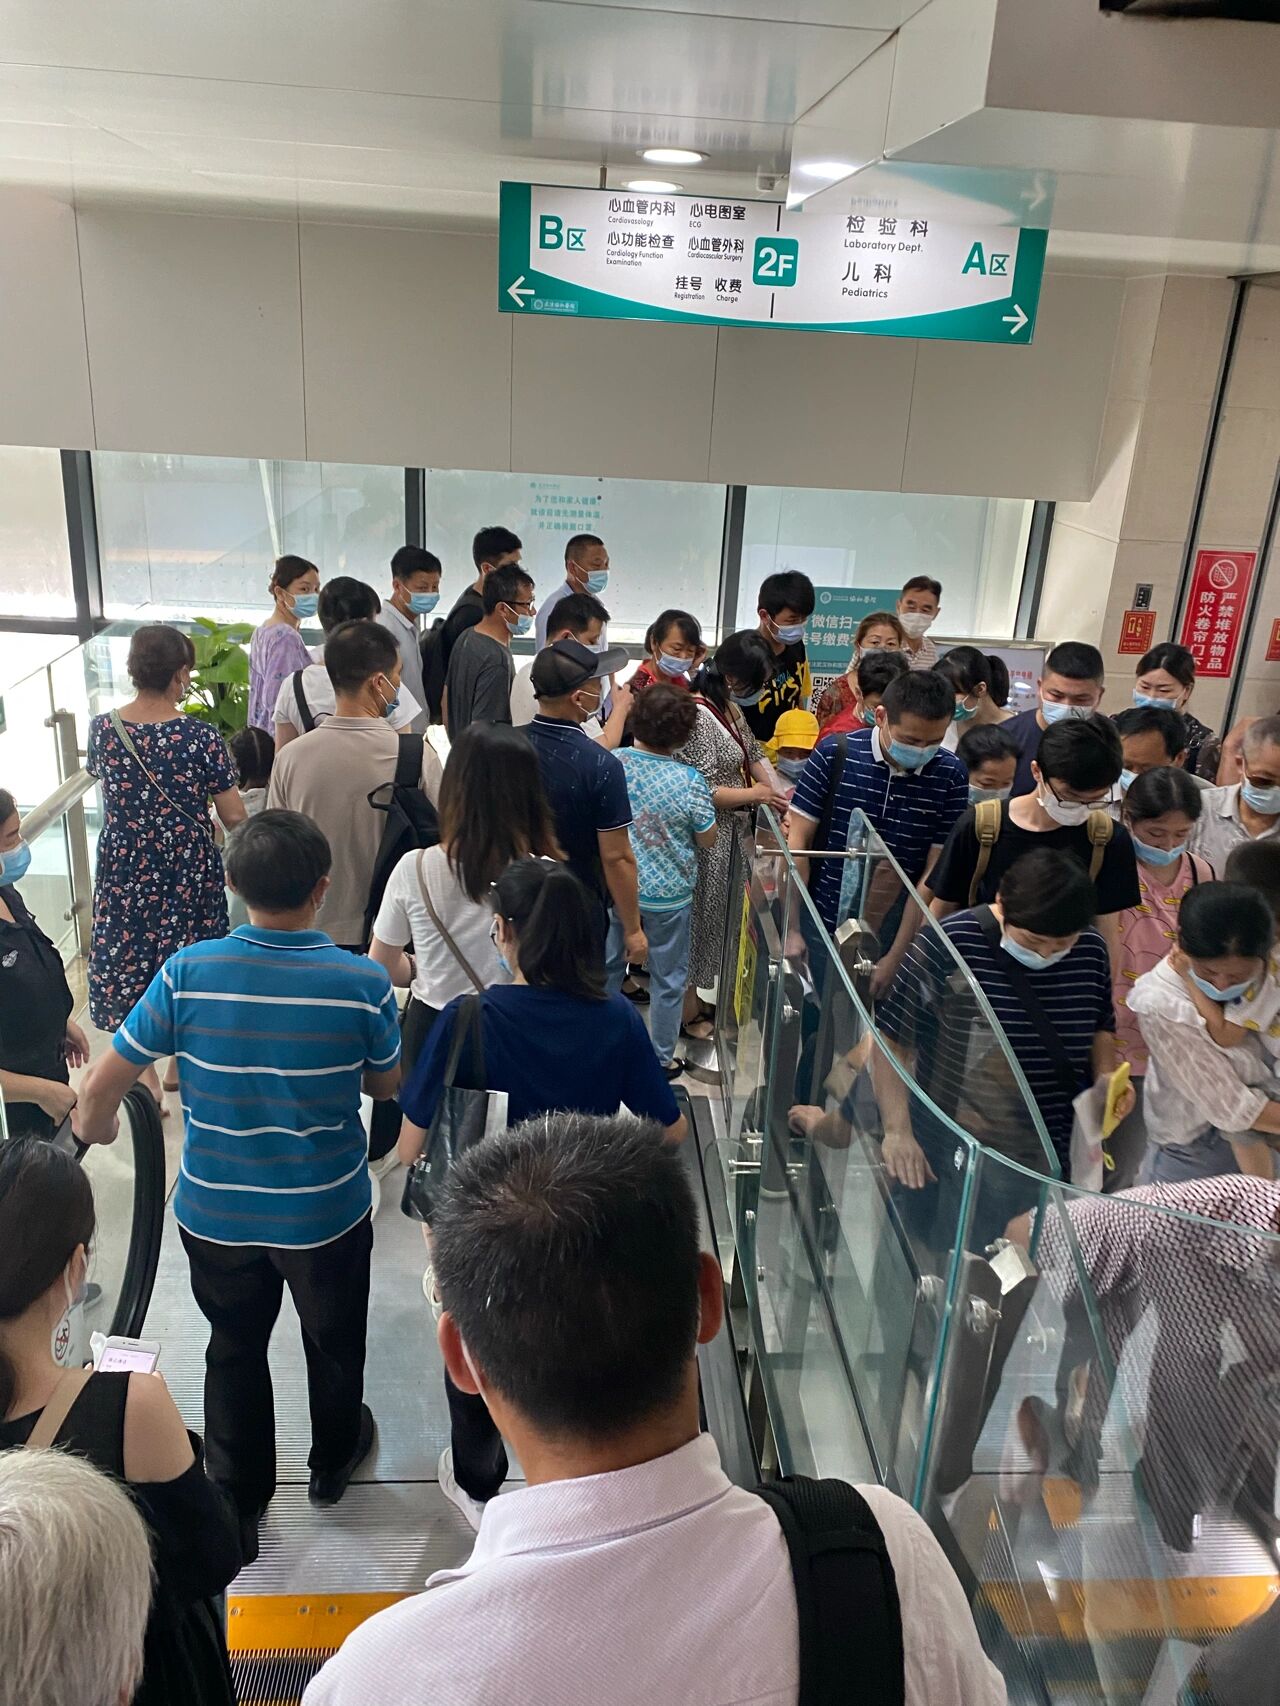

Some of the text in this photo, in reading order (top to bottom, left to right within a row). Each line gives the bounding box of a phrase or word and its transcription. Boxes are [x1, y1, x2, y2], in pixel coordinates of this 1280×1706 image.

[608, 198, 676, 216] 心血管内科
[690, 203, 746, 220] 心电图室
[689, 220, 702, 228] ECG
[846, 215, 928, 237] 检验科
[539, 215, 587, 251] B区
[607, 231, 674, 249] 心功能检查
[688, 236, 744, 253] 心血管外科
[844, 239, 923, 253] Laboratory Dept.
[606, 248, 664, 259] Cardiology Function
[606, 257, 642, 266] Examination
[723, 254, 743, 262] Surgery
[962, 242, 1010, 276] A区
[757, 247, 794, 278] 2F
[841, 261, 892, 284] 儿科
[675, 275, 742, 293] 挂号 收费
[674, 292, 738, 303] Registration Charge
[841, 287, 888, 299] Pediatrics
[1206, 592, 1238, 670] 严禁堆放物品
